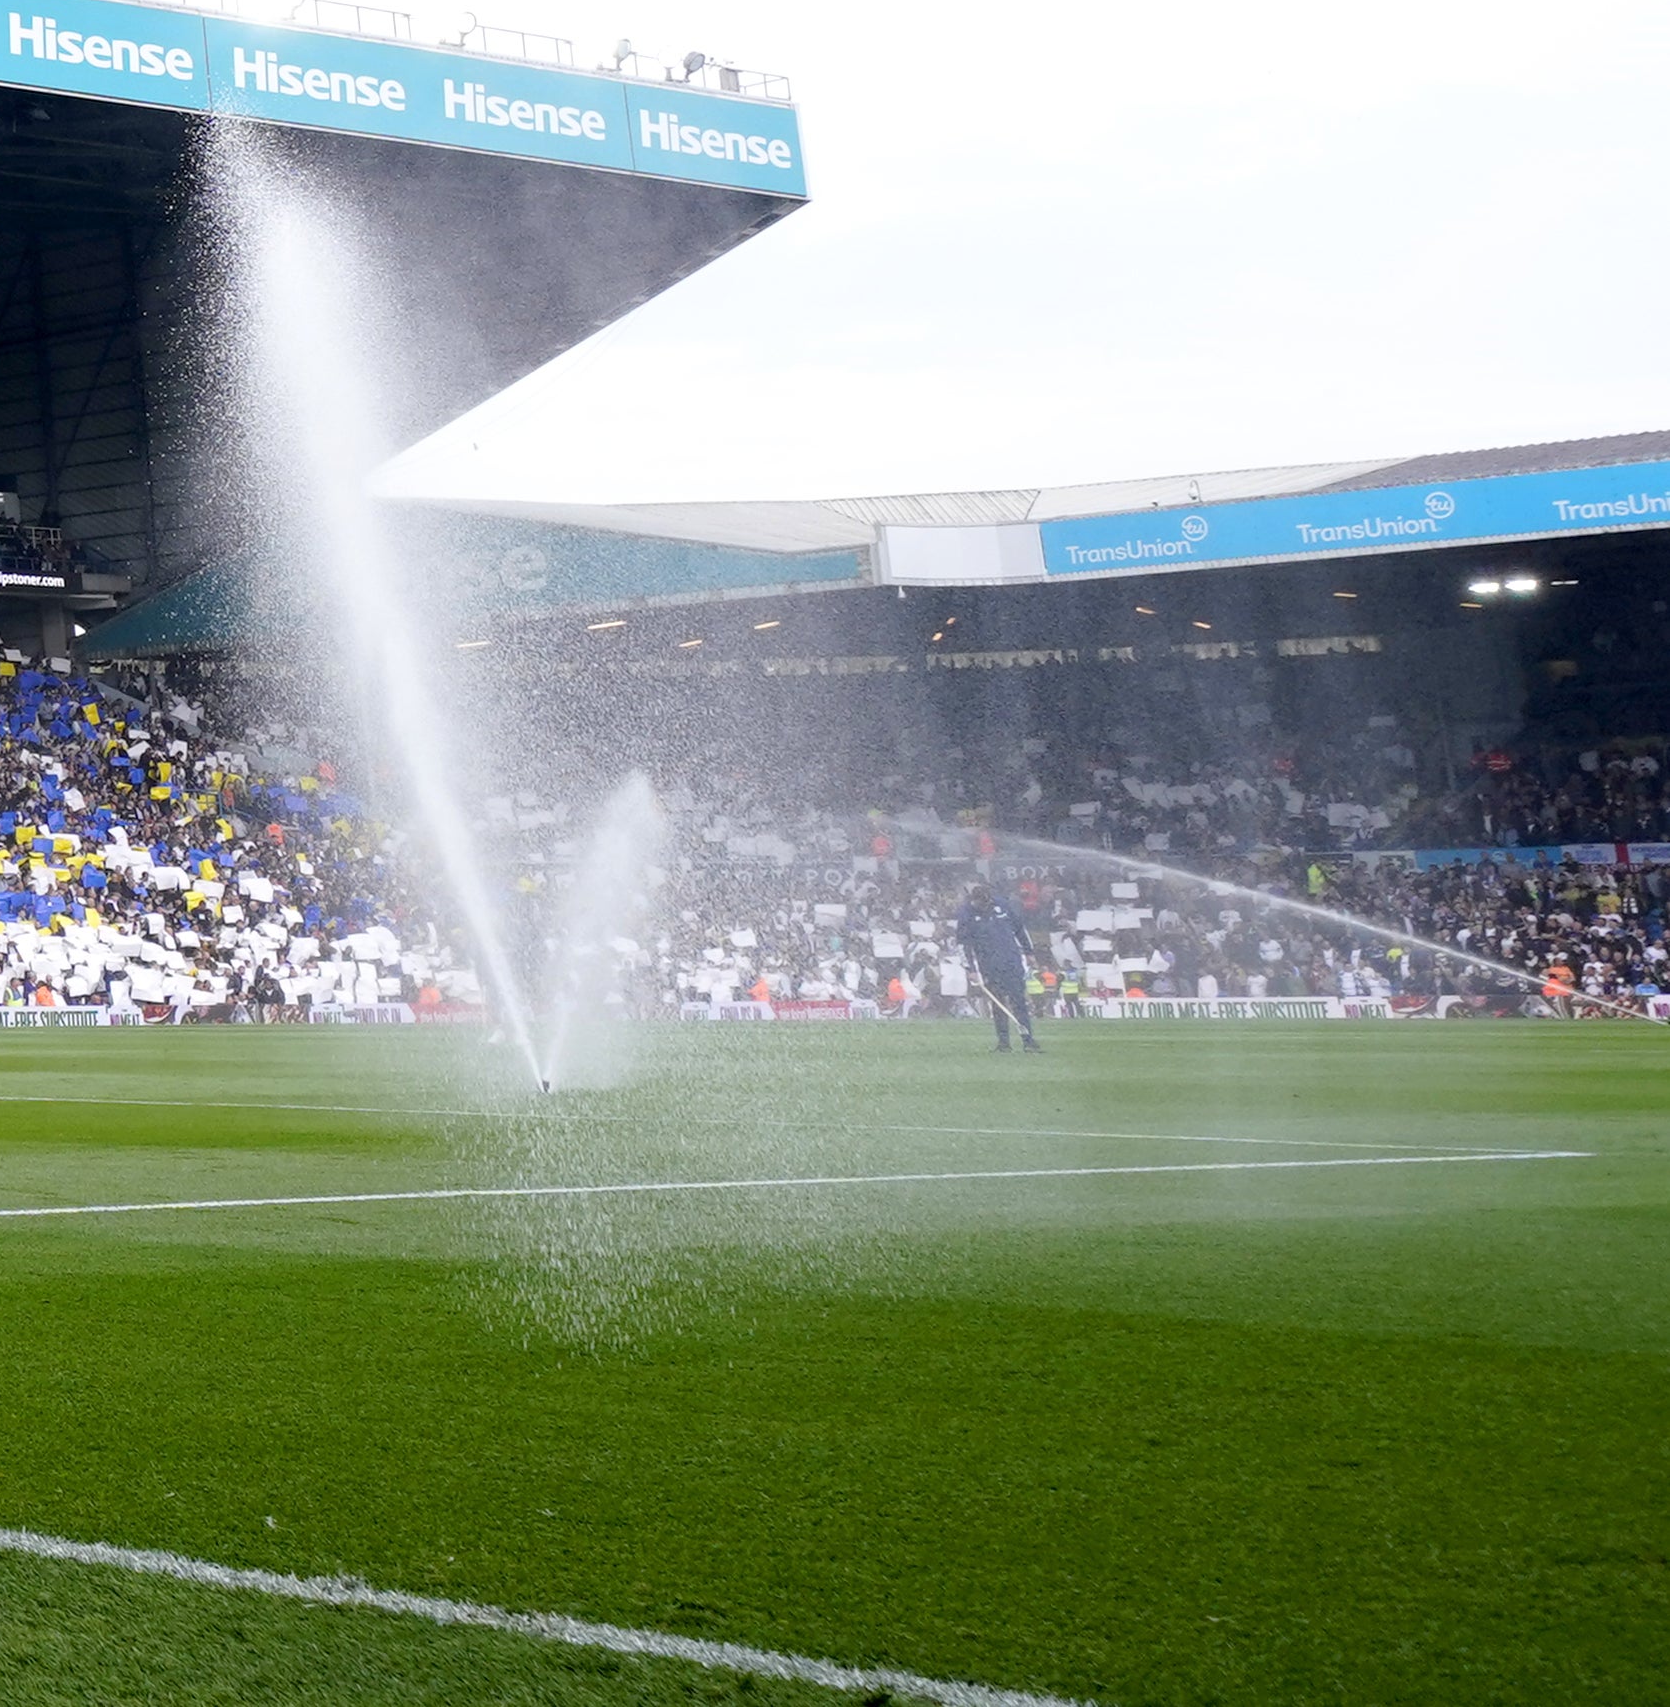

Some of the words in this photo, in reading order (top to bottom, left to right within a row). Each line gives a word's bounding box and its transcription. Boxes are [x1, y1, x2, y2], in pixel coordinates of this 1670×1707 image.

[8, 11, 193, 82] Hisense
[232, 45, 406, 113] Hisense
[442, 78, 606, 141] Hisense
[638, 109, 792, 171] Hisense
[1065, 537, 1192, 564] TransUnion
[1296, 515, 1436, 544] TransUnion
[40, 1010, 99, 1027] SUBSTITUTE
[1148, 1002, 1174, 1018] OUR
[1178, 1002, 1247, 1019] MEAT-FREE
[1250, 1001, 1328, 1018] SUBSTITUTE
